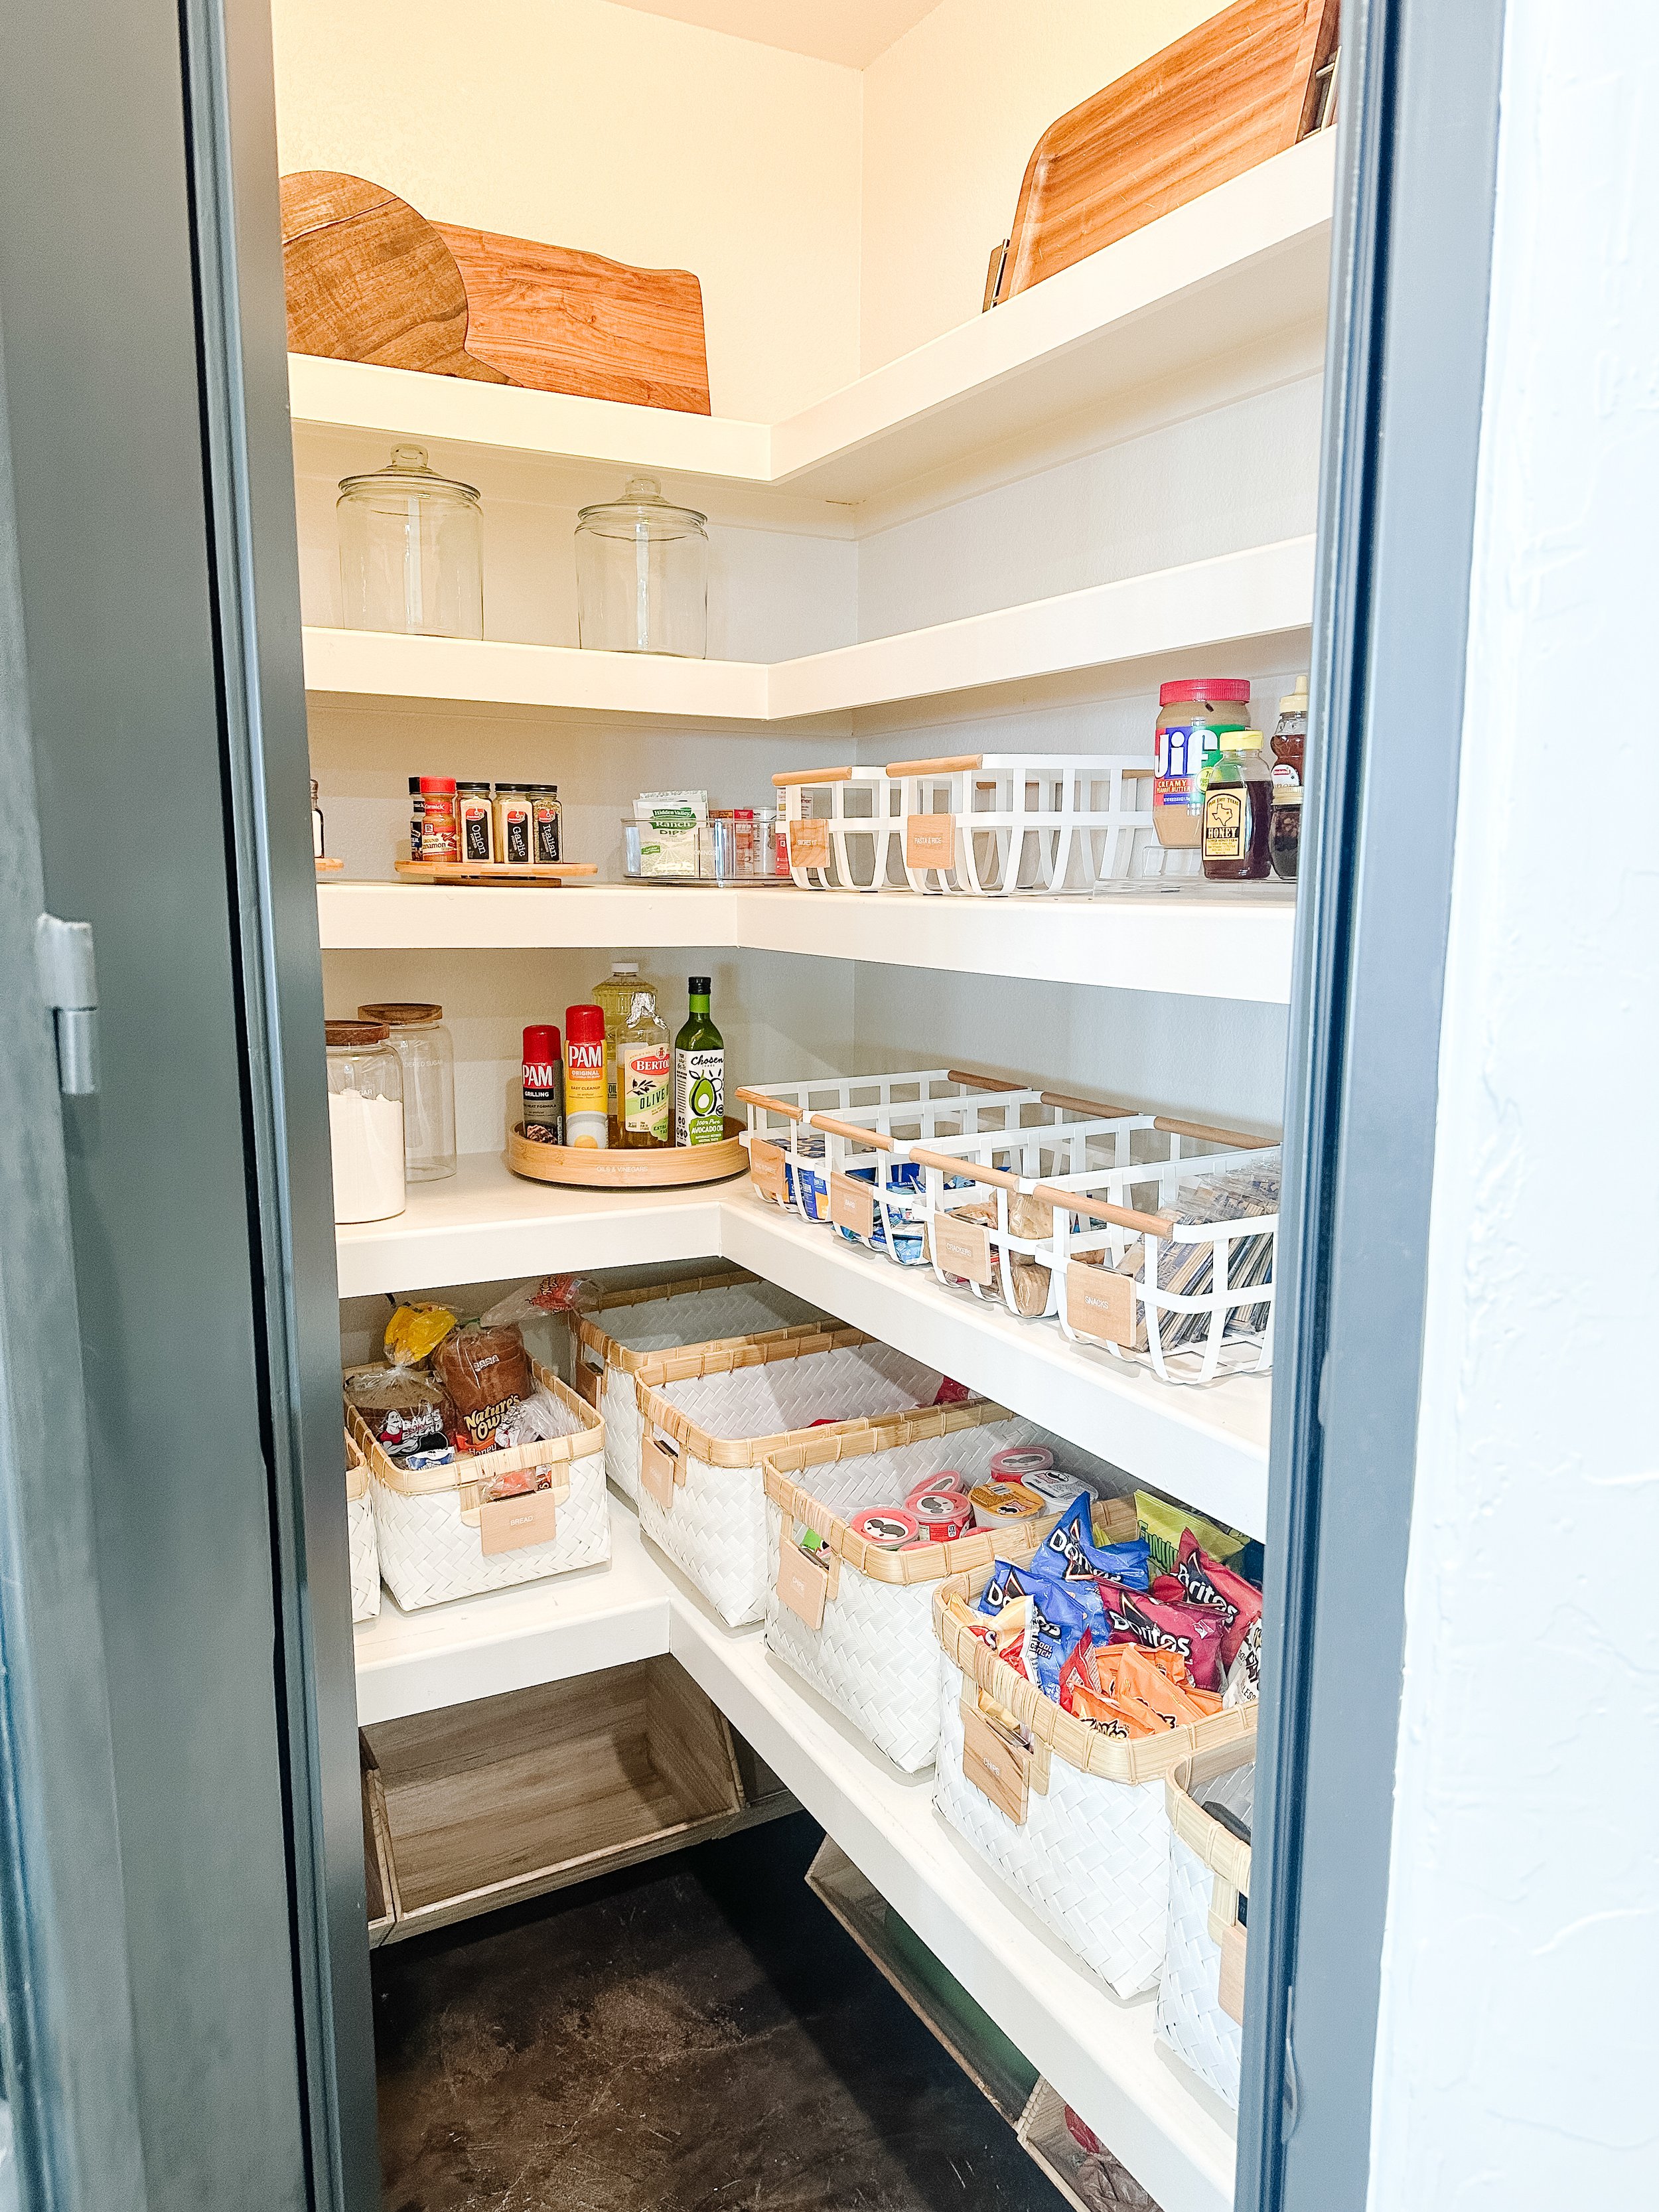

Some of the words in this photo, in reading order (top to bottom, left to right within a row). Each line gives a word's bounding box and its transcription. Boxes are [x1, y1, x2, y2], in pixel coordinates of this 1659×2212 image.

[1155, 729, 1218, 778] Jif
[472, 824, 486, 855] Onion
[512, 826, 526, 857] Garlic
[543, 824, 557, 858] Italian
[1208, 827, 1238, 838] HONEY
[569, 1045, 602, 1068] PAM
[690, 1054, 724, 1065] Chosen
[522, 1064, 553, 1087] PAM
[609, 1084, 617, 1094] OIL
[640, 1088, 665, 1110] OLIVE
[691, 1125, 717, 1134] AVOCADO
[946, 1242, 972, 1256] CRACKERS
[1084, 1295, 1109, 1309] SNACKS
[402, 1408, 441, 1431] DAVE'S
[465, 1395, 520, 1428] Nature's
[510, 1515, 534, 1526] BREAD
[1108, 1610, 1190, 1658] Doritos
[1039, 1642, 1053, 1652] OOL
[982, 1757, 1001, 1777] CHIPS
